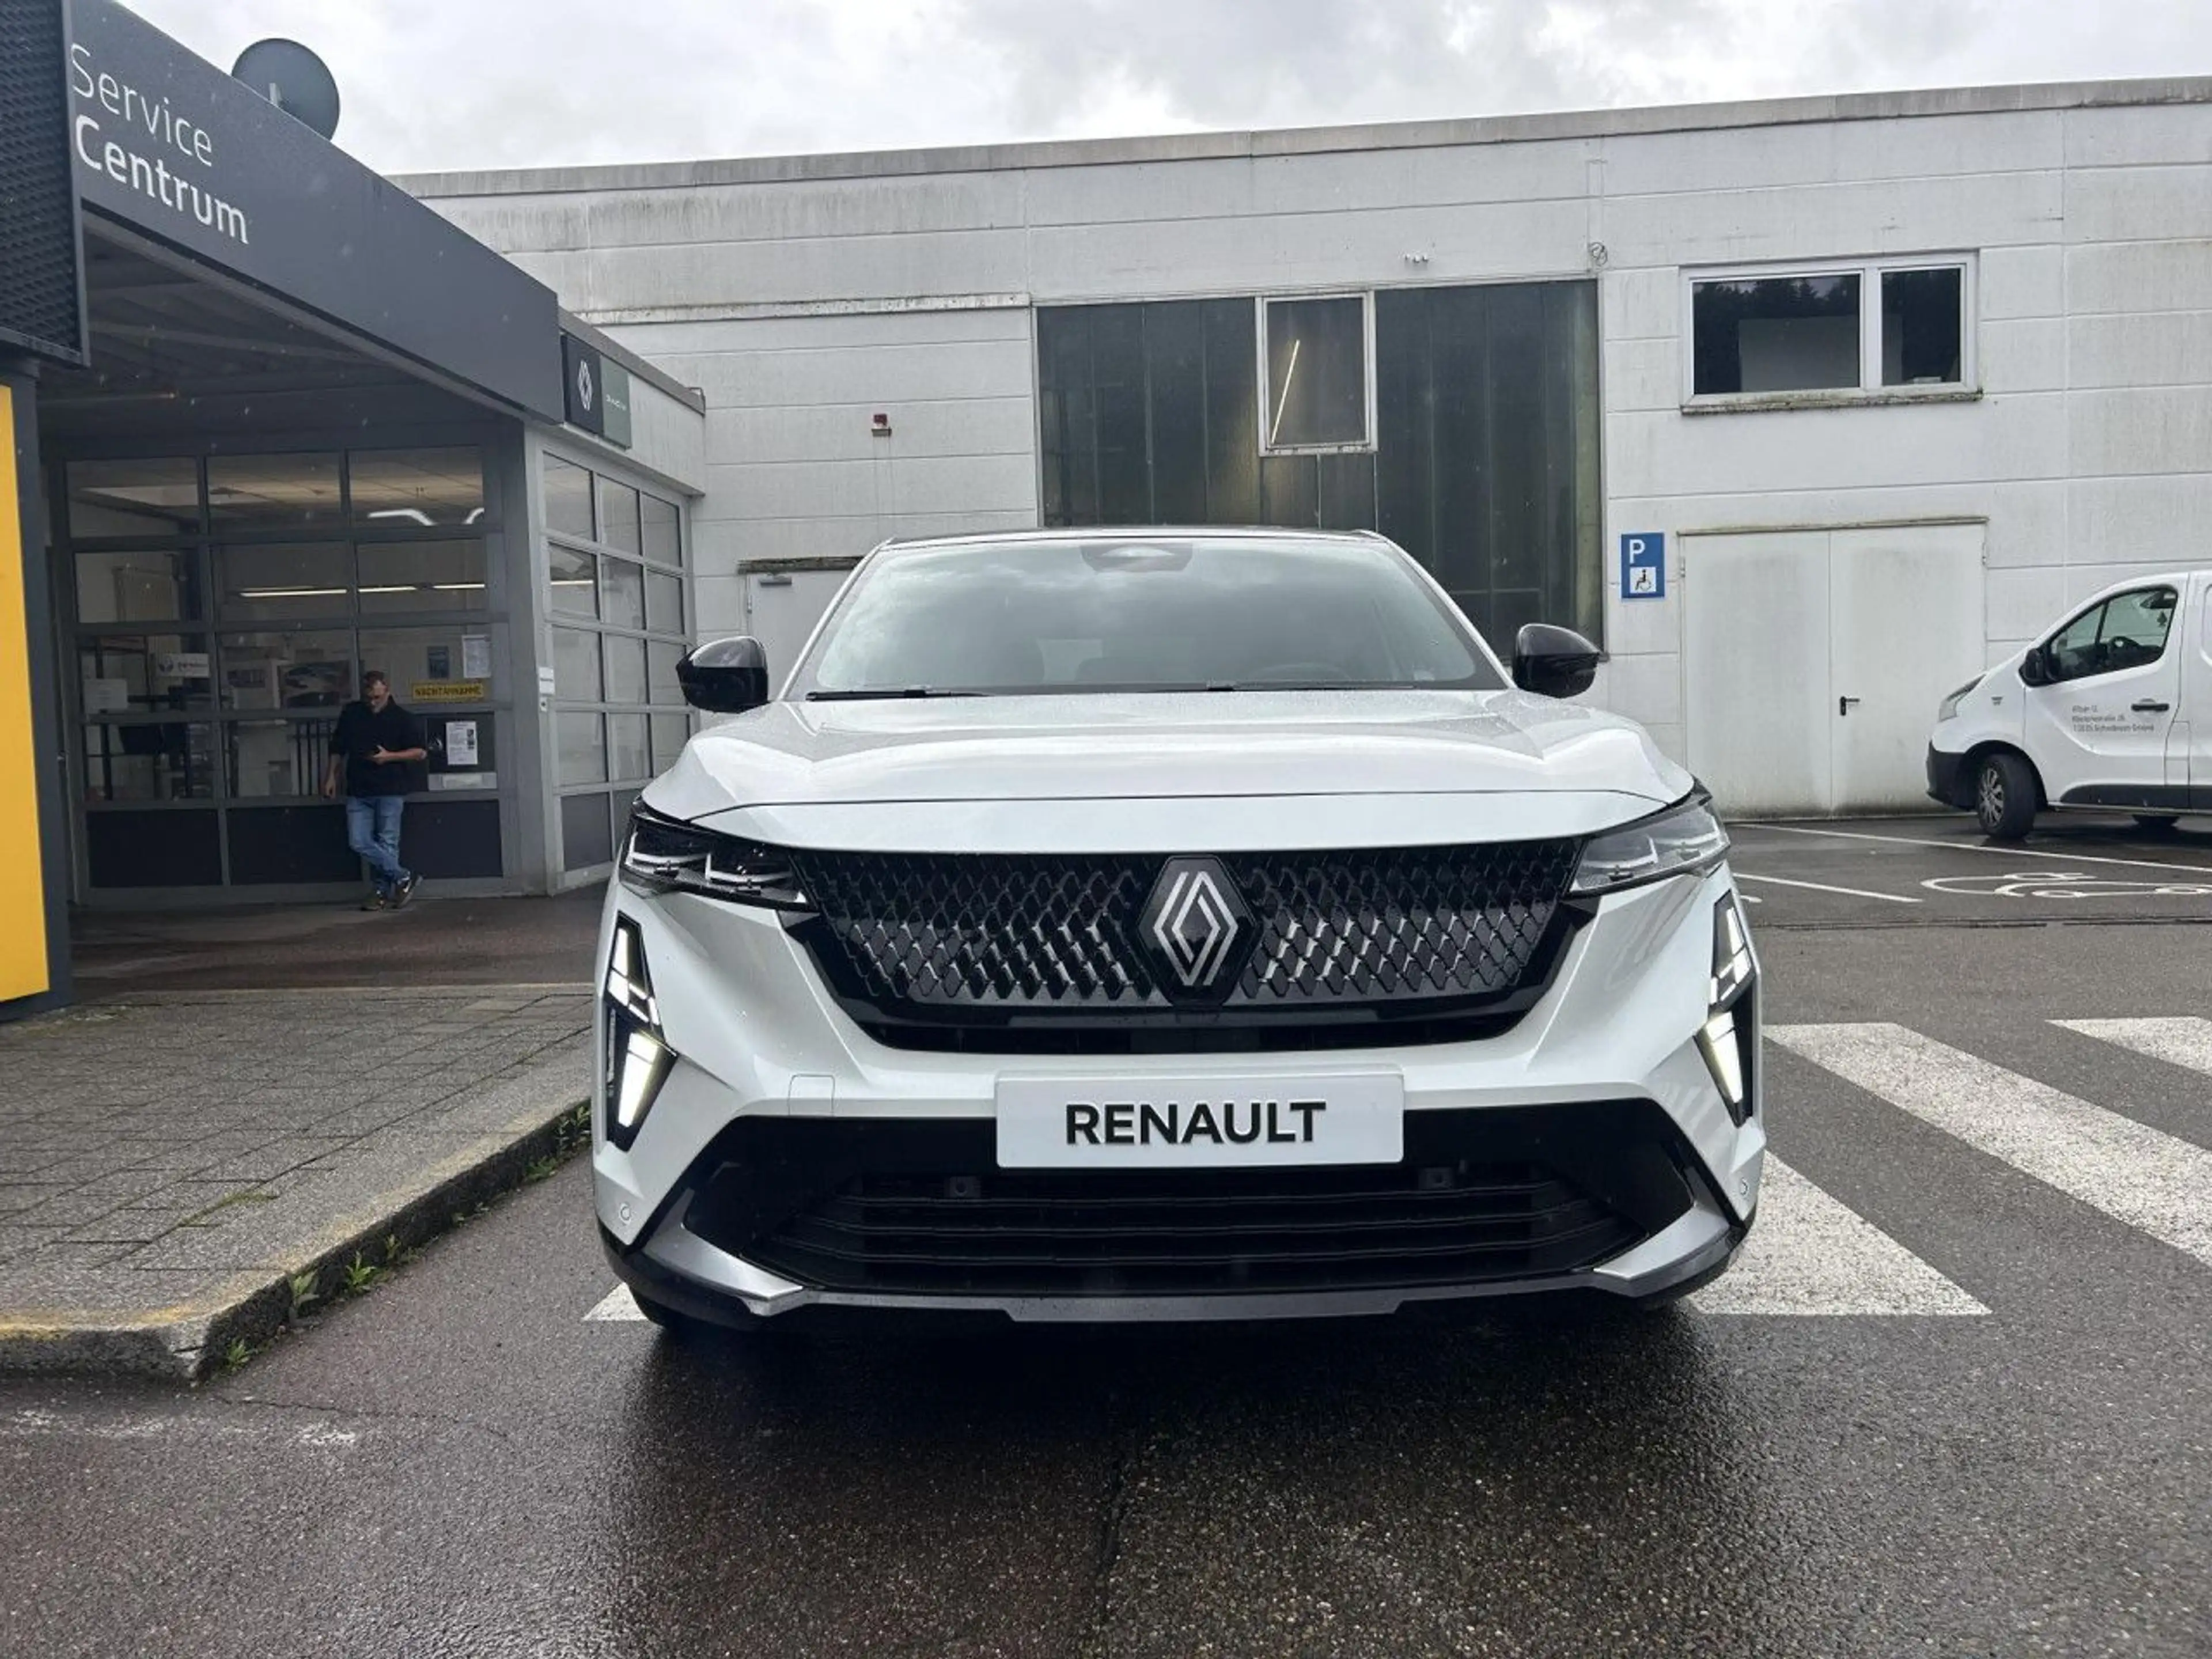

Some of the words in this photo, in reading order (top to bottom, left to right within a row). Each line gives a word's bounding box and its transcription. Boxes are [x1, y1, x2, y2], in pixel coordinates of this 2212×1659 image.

[71, 43, 212, 166] Service
[75, 115, 249, 244] Centrum
[1629, 539, 1646, 564] P
[1066, 1100, 1326, 1145] RENAULT
